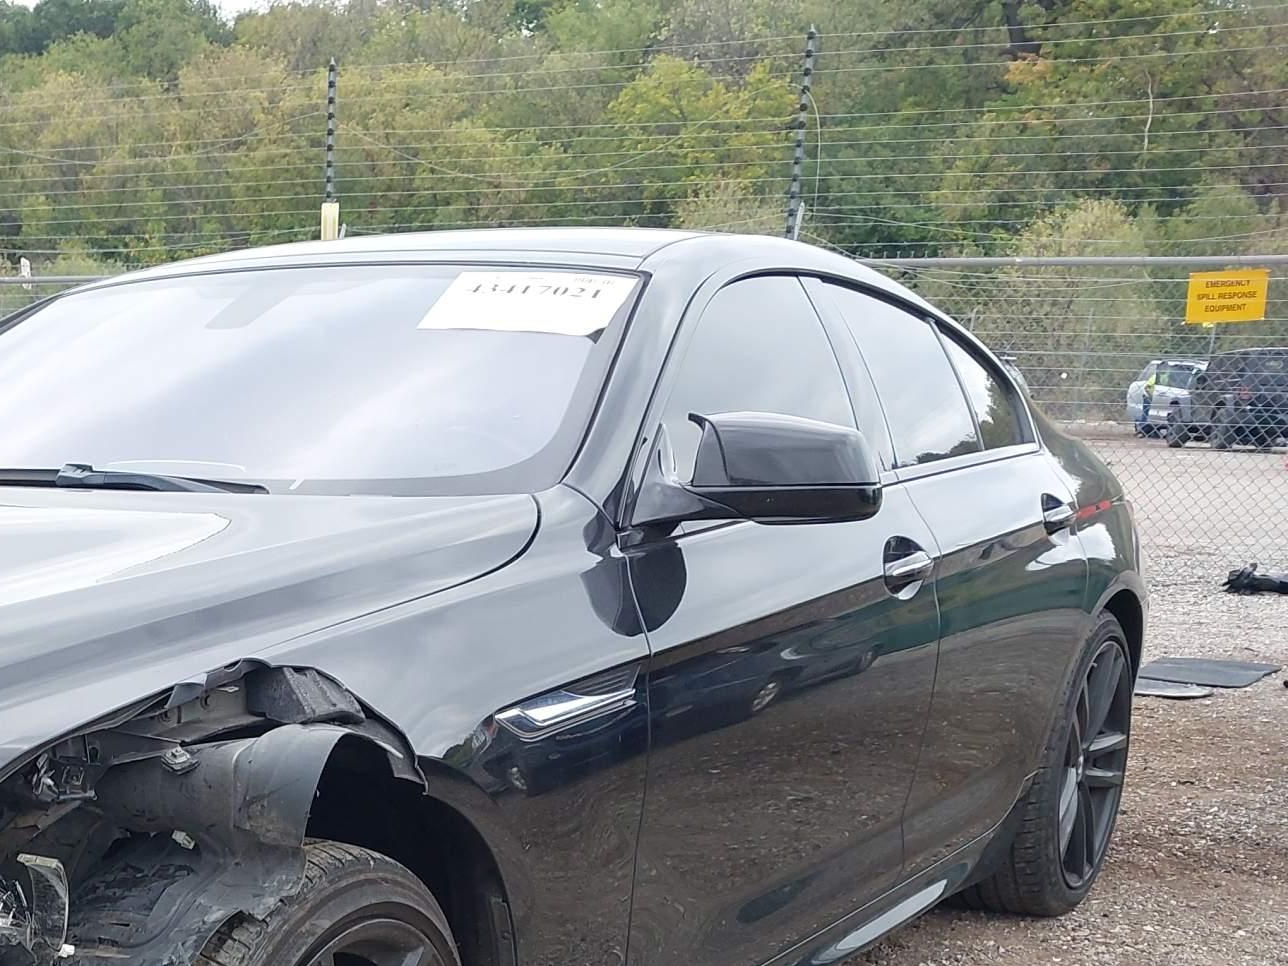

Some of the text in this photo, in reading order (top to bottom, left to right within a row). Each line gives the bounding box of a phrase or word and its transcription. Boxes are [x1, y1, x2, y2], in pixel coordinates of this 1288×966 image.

[1205, 280, 1250, 288] EMERGENCY
[1197, 290, 1257, 300] SPILL RESPONSE
[1204, 303, 1247, 312] EQUIPMENT
